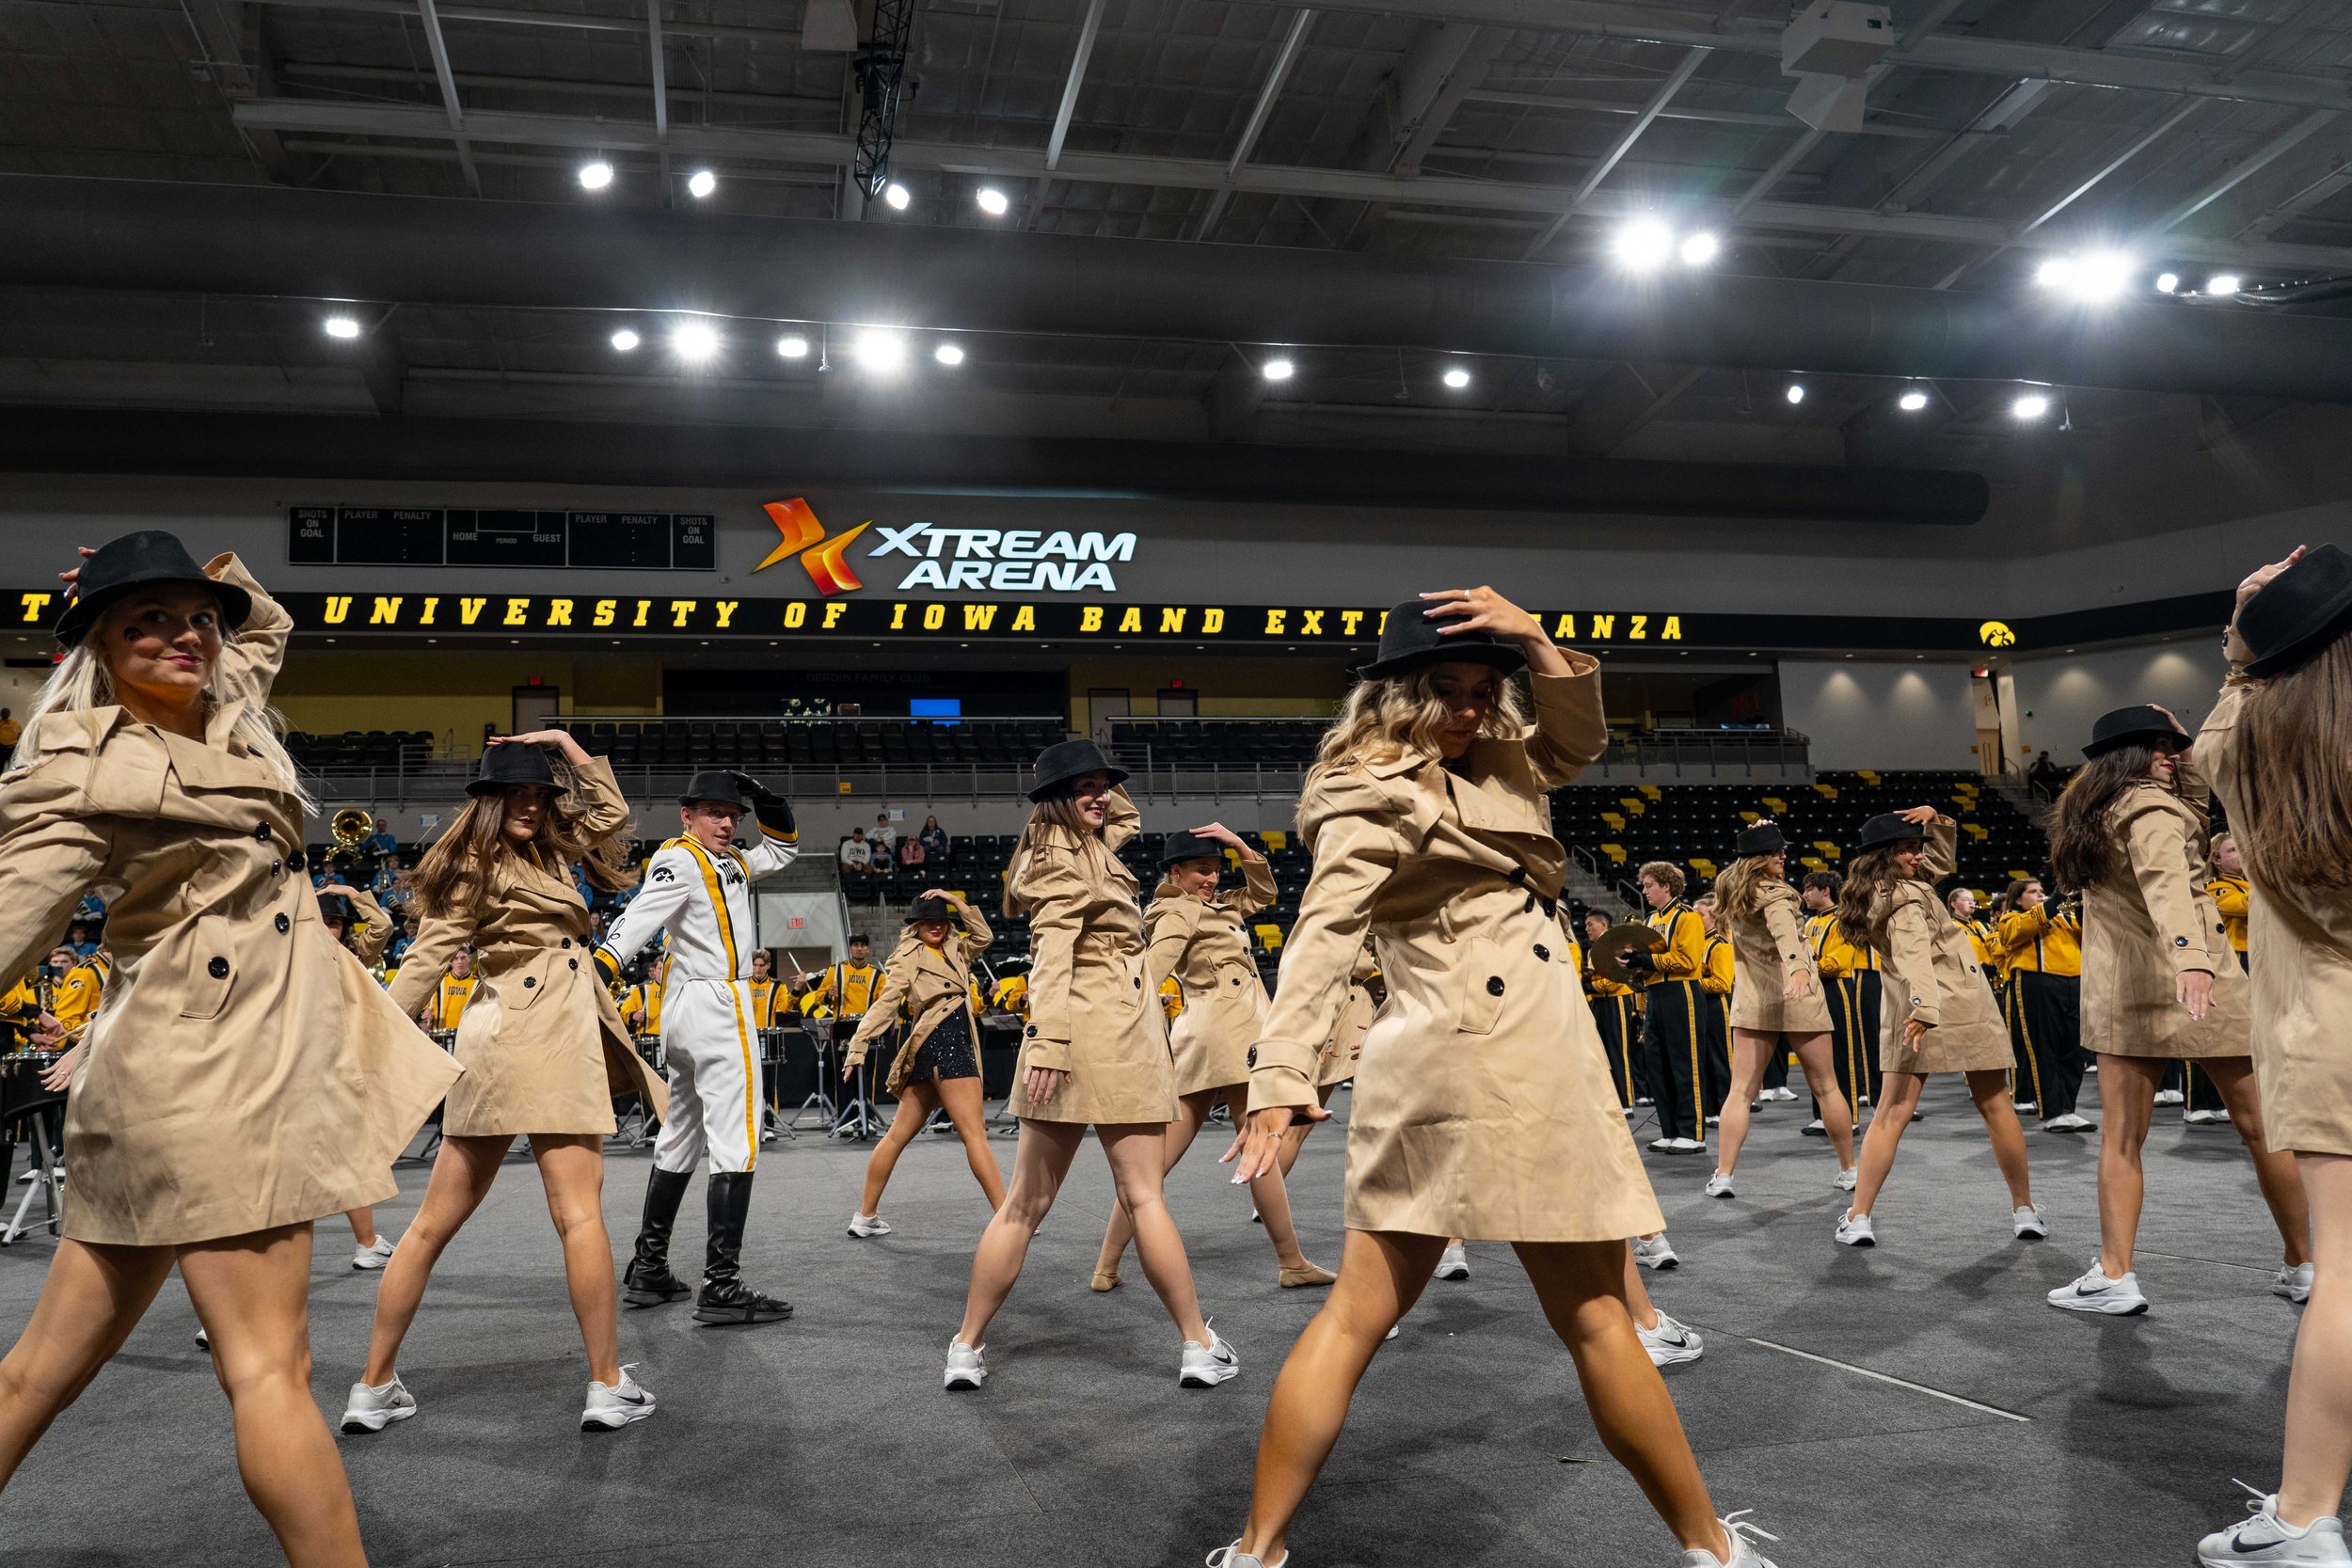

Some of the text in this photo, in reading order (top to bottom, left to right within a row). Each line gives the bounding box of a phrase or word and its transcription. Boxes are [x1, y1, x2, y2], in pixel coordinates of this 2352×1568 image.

[297, 509, 327, 519] SHOTS
[344, 510, 432, 520] PLAYER PENALTY
[306, 519, 319, 529] ON
[575, 514, 658, 525] PLAYER PENALTY
[680, 517, 707, 526] SHOTS
[300, 529, 325, 538] GOAL
[688, 526, 700, 535] ON
[453, 531, 479, 541] HOME
[532, 533, 562, 543] GUEST
[682, 534, 705, 544] GOAL
[867, 522, 1137, 562] XTREAM
[897, 560, 1117, 593] ARENA
[324, 596, 1681, 640] UNIVERSITY OF IOWA BAND EXTANZA
[854, 672, 896, 683] FAMILY
[899, 673, 931, 683] CLUB
[849, 974, 866, 985] IOWA
[448, 986, 468, 996] IOWA
